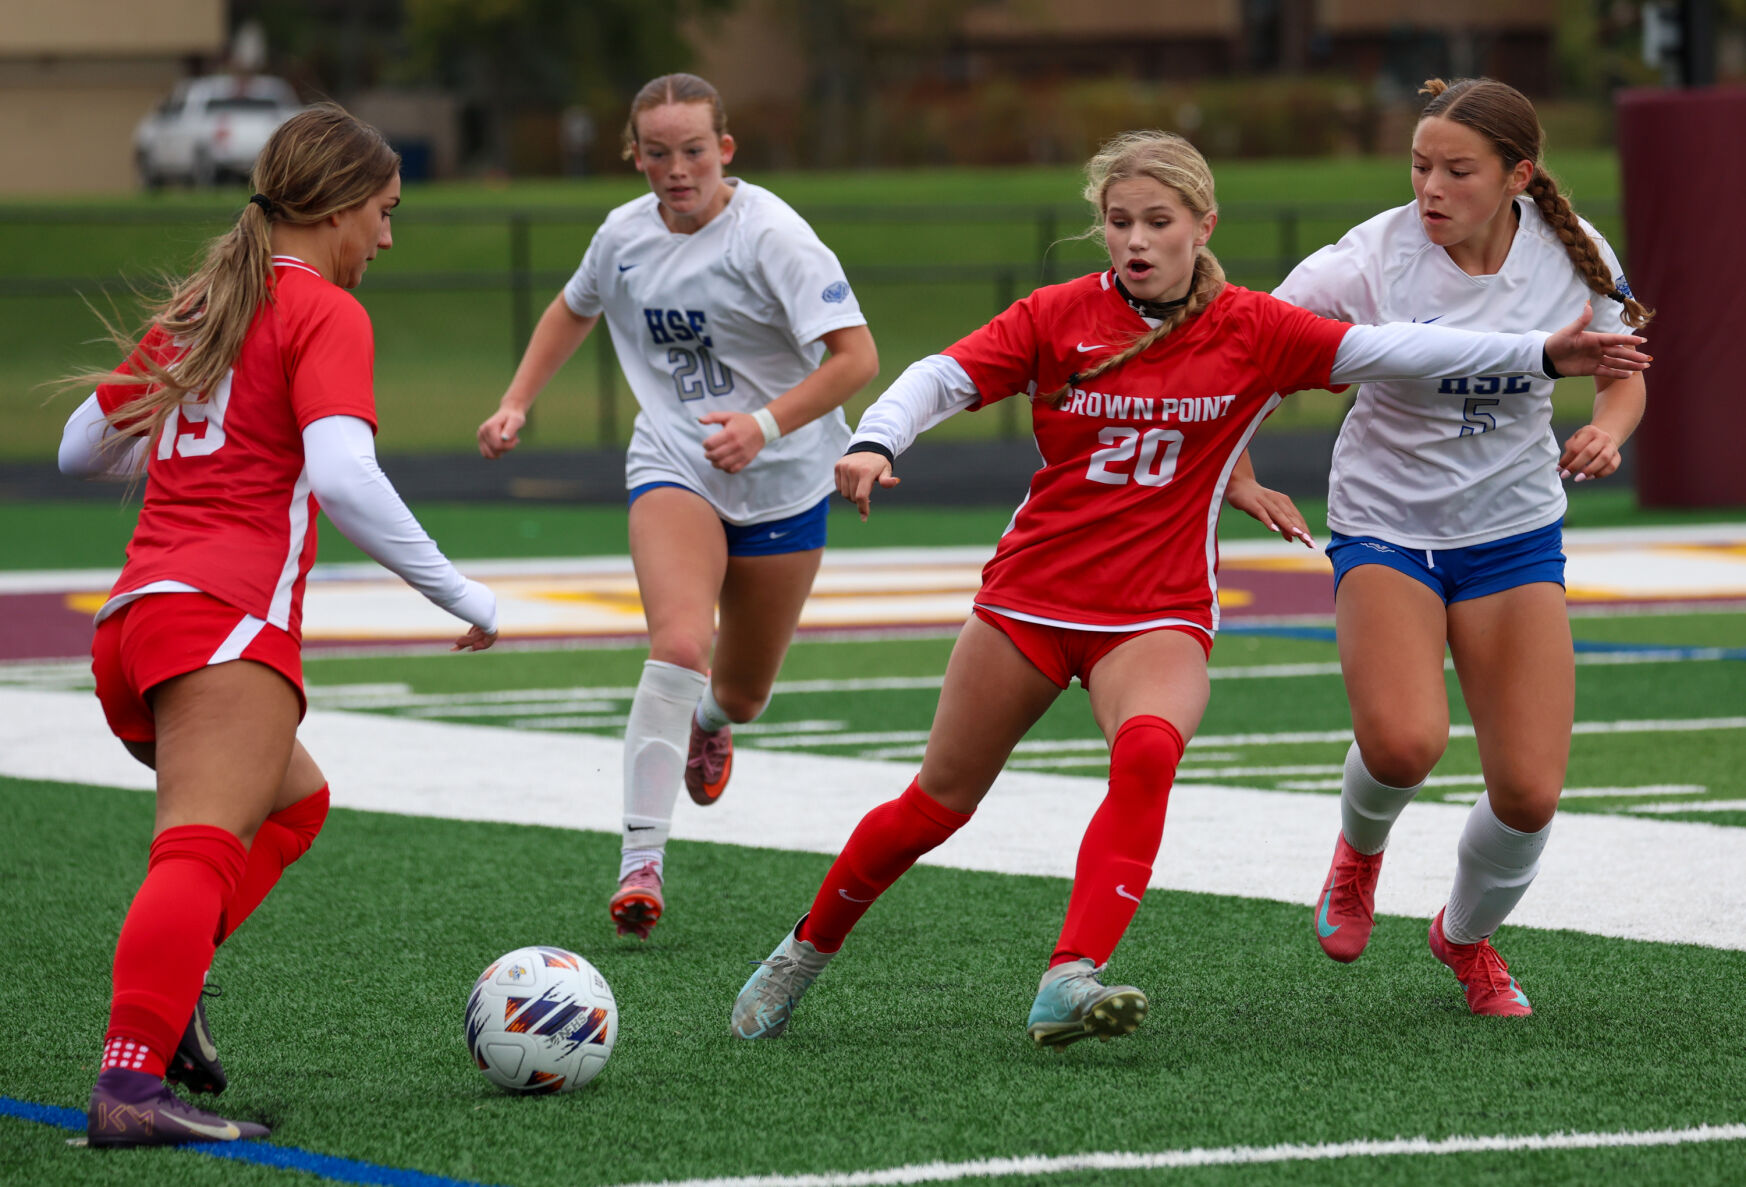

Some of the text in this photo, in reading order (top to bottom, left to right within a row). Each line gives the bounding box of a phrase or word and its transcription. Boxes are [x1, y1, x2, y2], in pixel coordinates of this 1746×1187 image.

[643, 308, 714, 349] HSE
[667, 347, 735, 402] 20
[157, 362, 234, 461] 19
[1060, 388, 1236, 422] CROWN POINT
[1459, 398, 1500, 438] 5
[1085, 426, 1185, 487] 20
